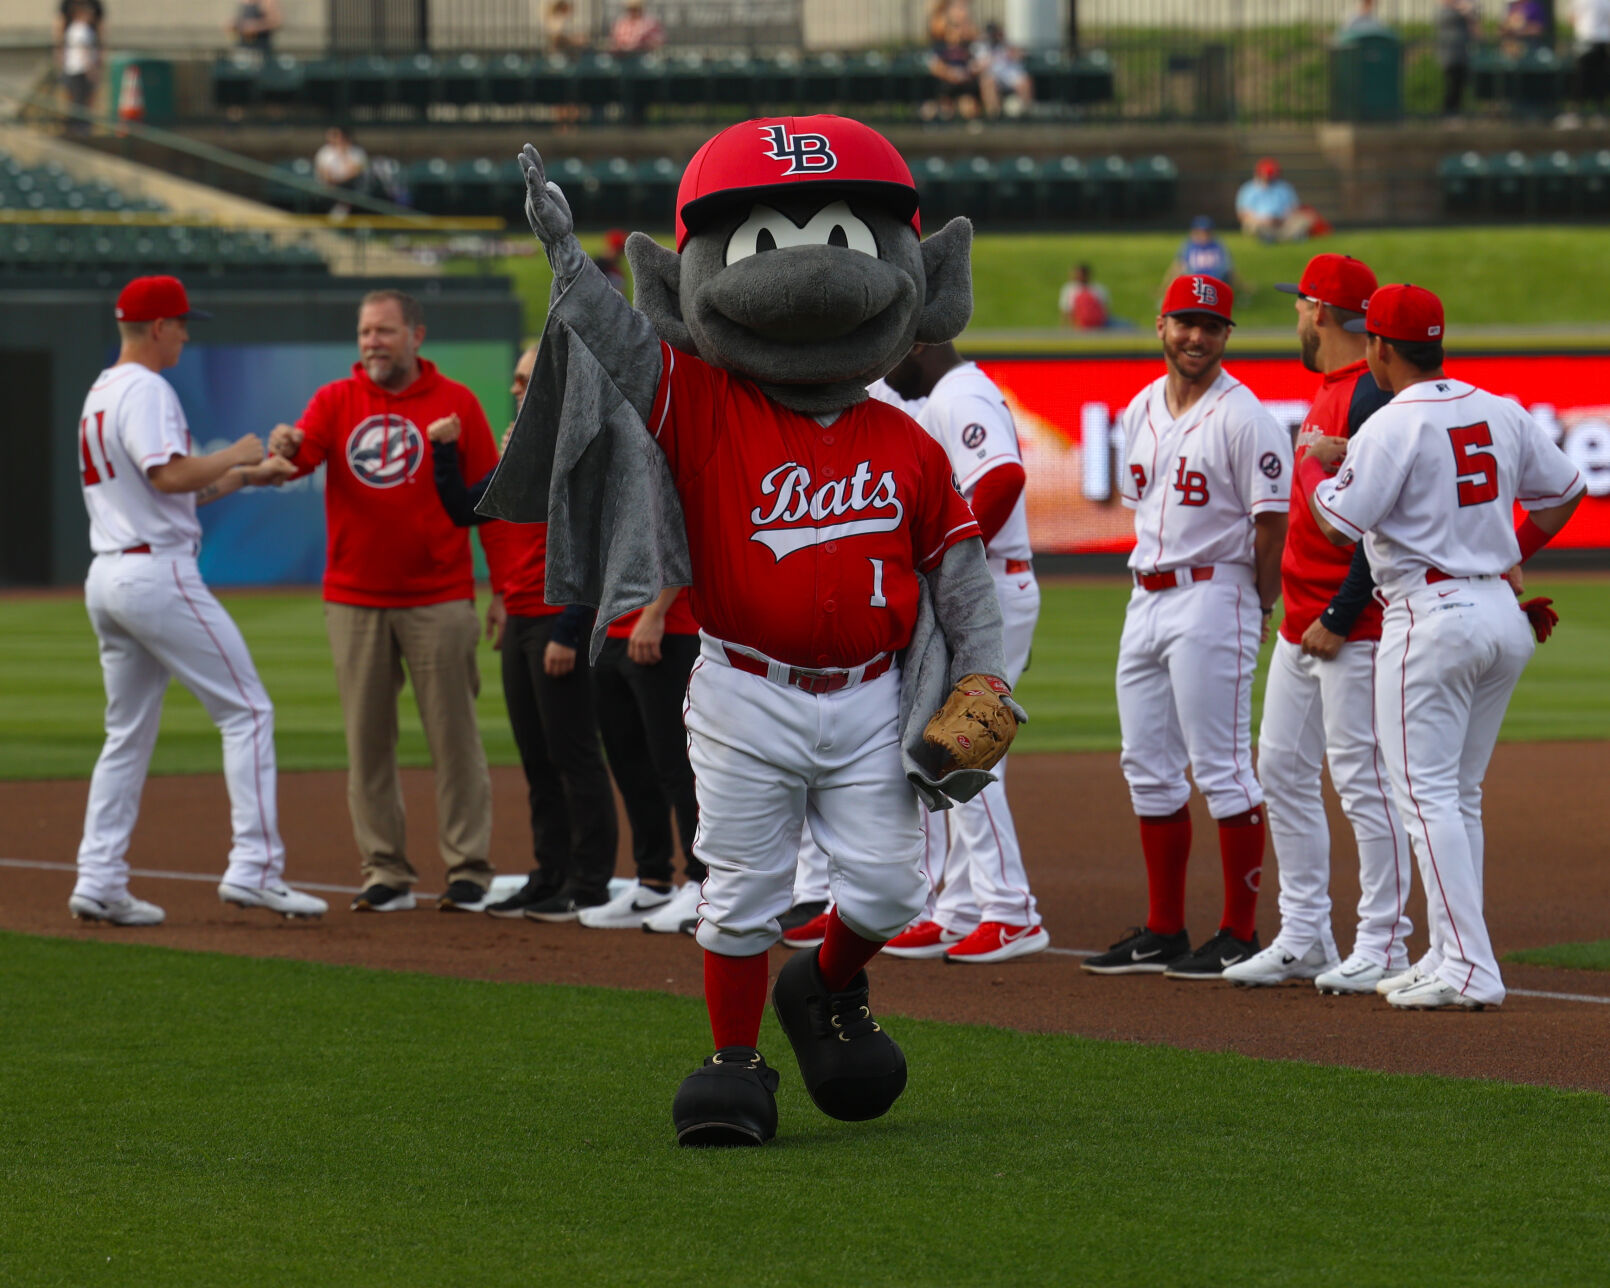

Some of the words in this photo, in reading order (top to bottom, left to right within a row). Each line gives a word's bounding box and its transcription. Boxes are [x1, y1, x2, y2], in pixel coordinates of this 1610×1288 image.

[757, 124, 837, 176] LB
[1192, 277, 1218, 305] LB
[1172, 456, 1210, 507] LB
[1447, 420, 1499, 508] 5
[750, 459, 905, 530] Bats
[865, 556, 887, 608] 1
